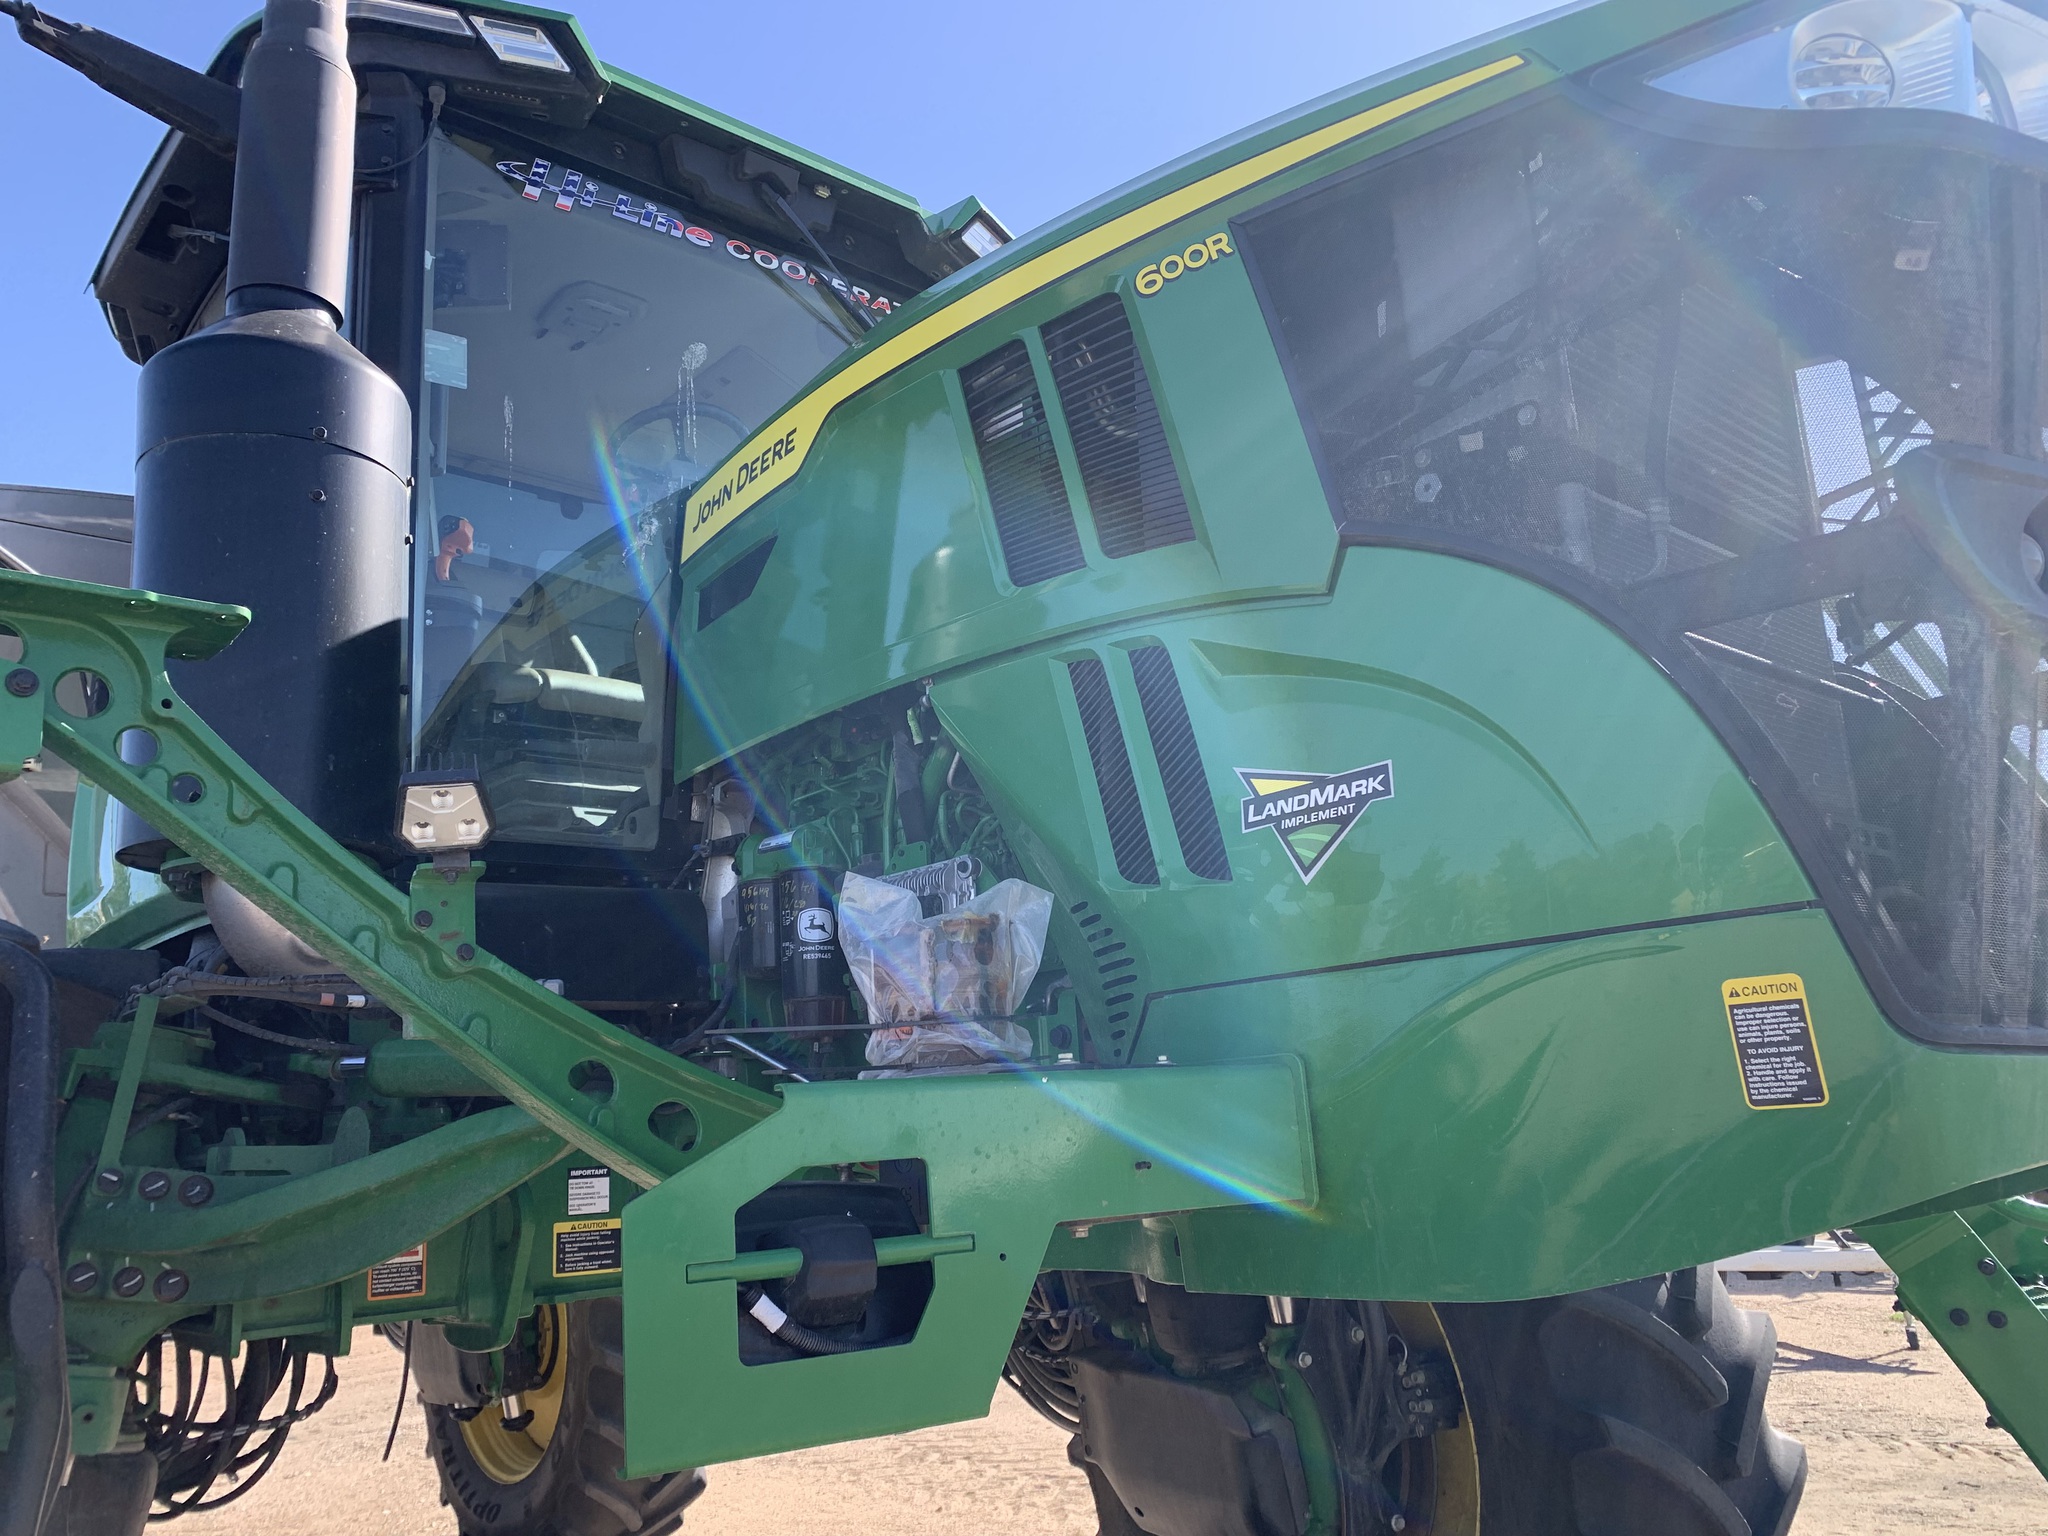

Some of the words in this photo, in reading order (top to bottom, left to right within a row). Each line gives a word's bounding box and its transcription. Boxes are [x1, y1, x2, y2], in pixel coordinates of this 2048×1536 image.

[1134, 231, 1234, 297] 600R
[692, 478, 734, 533] JOHN
[735, 427, 797, 495] DEERE
[1281, 803, 1356, 830] IMPLEMENT
[1742, 982, 1797, 996] CAUTION
